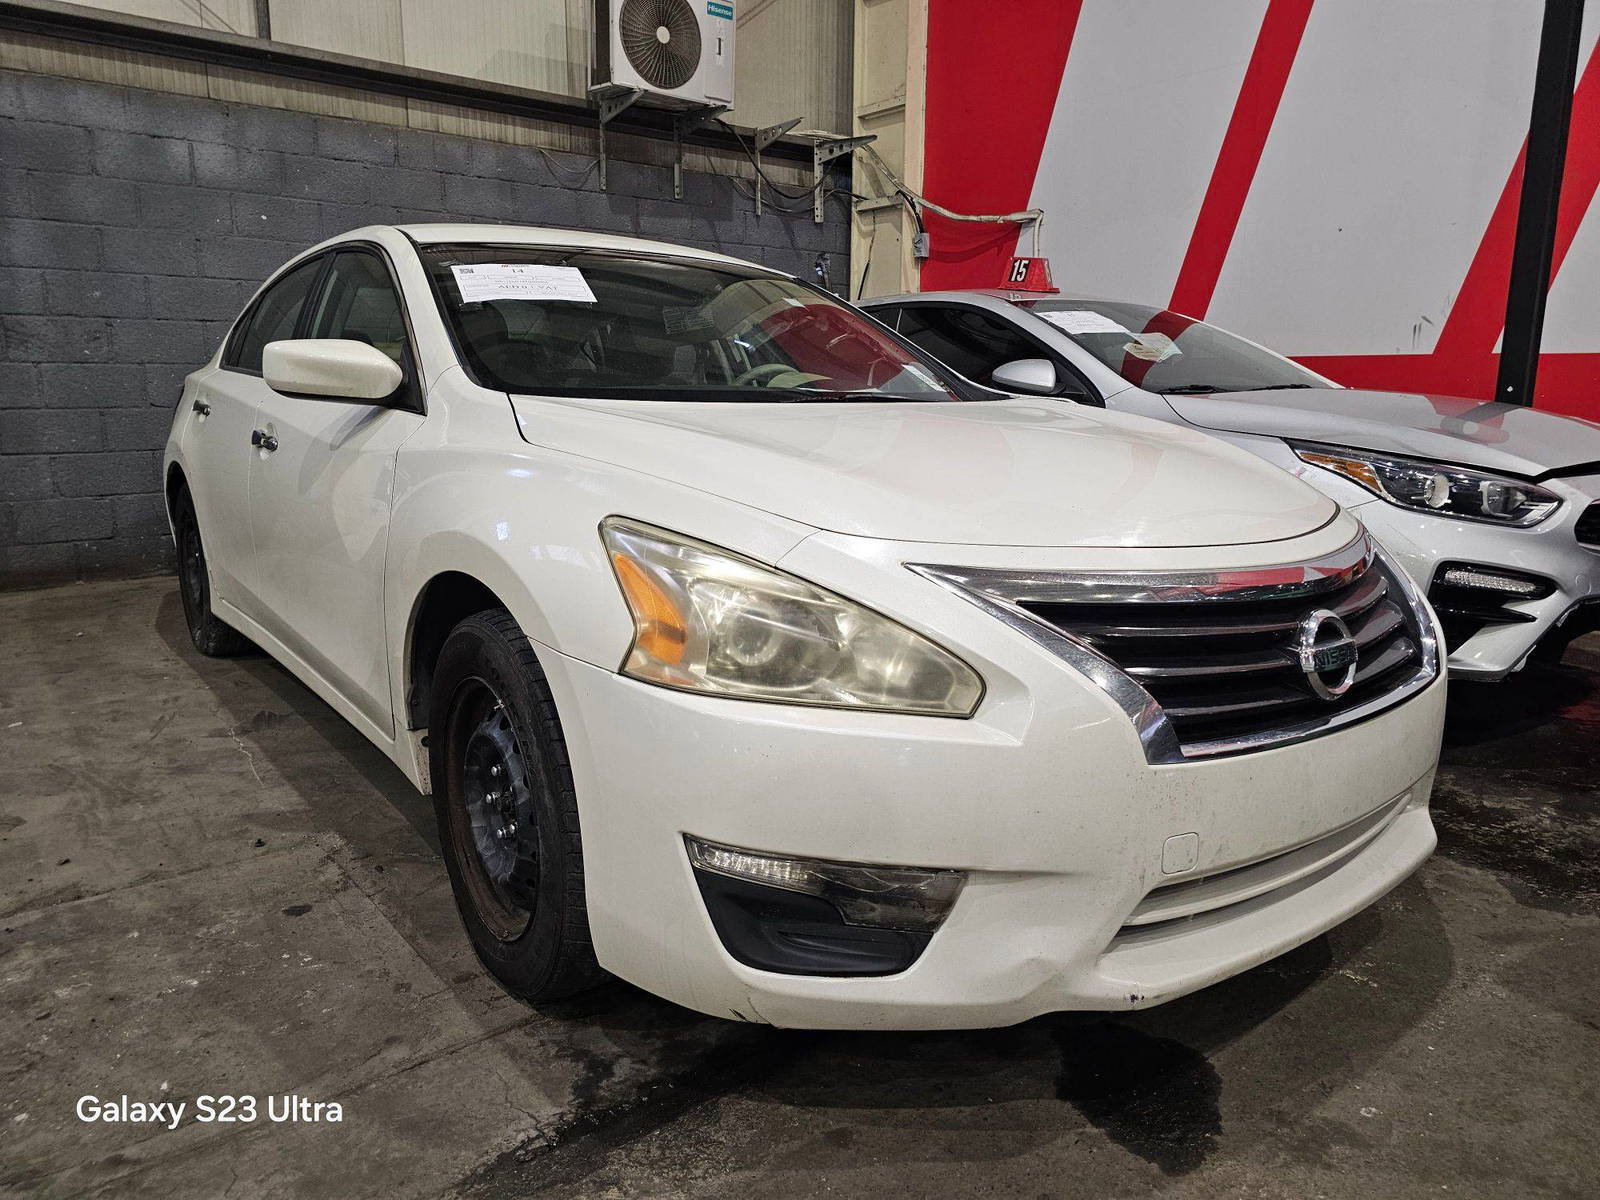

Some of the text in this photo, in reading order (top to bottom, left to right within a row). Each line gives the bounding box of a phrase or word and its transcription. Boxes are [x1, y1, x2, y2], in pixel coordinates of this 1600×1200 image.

[708, 4, 733, 16] Hisense
[1011, 259, 1029, 281] 15
[1314, 645, 1355, 667] NISS
